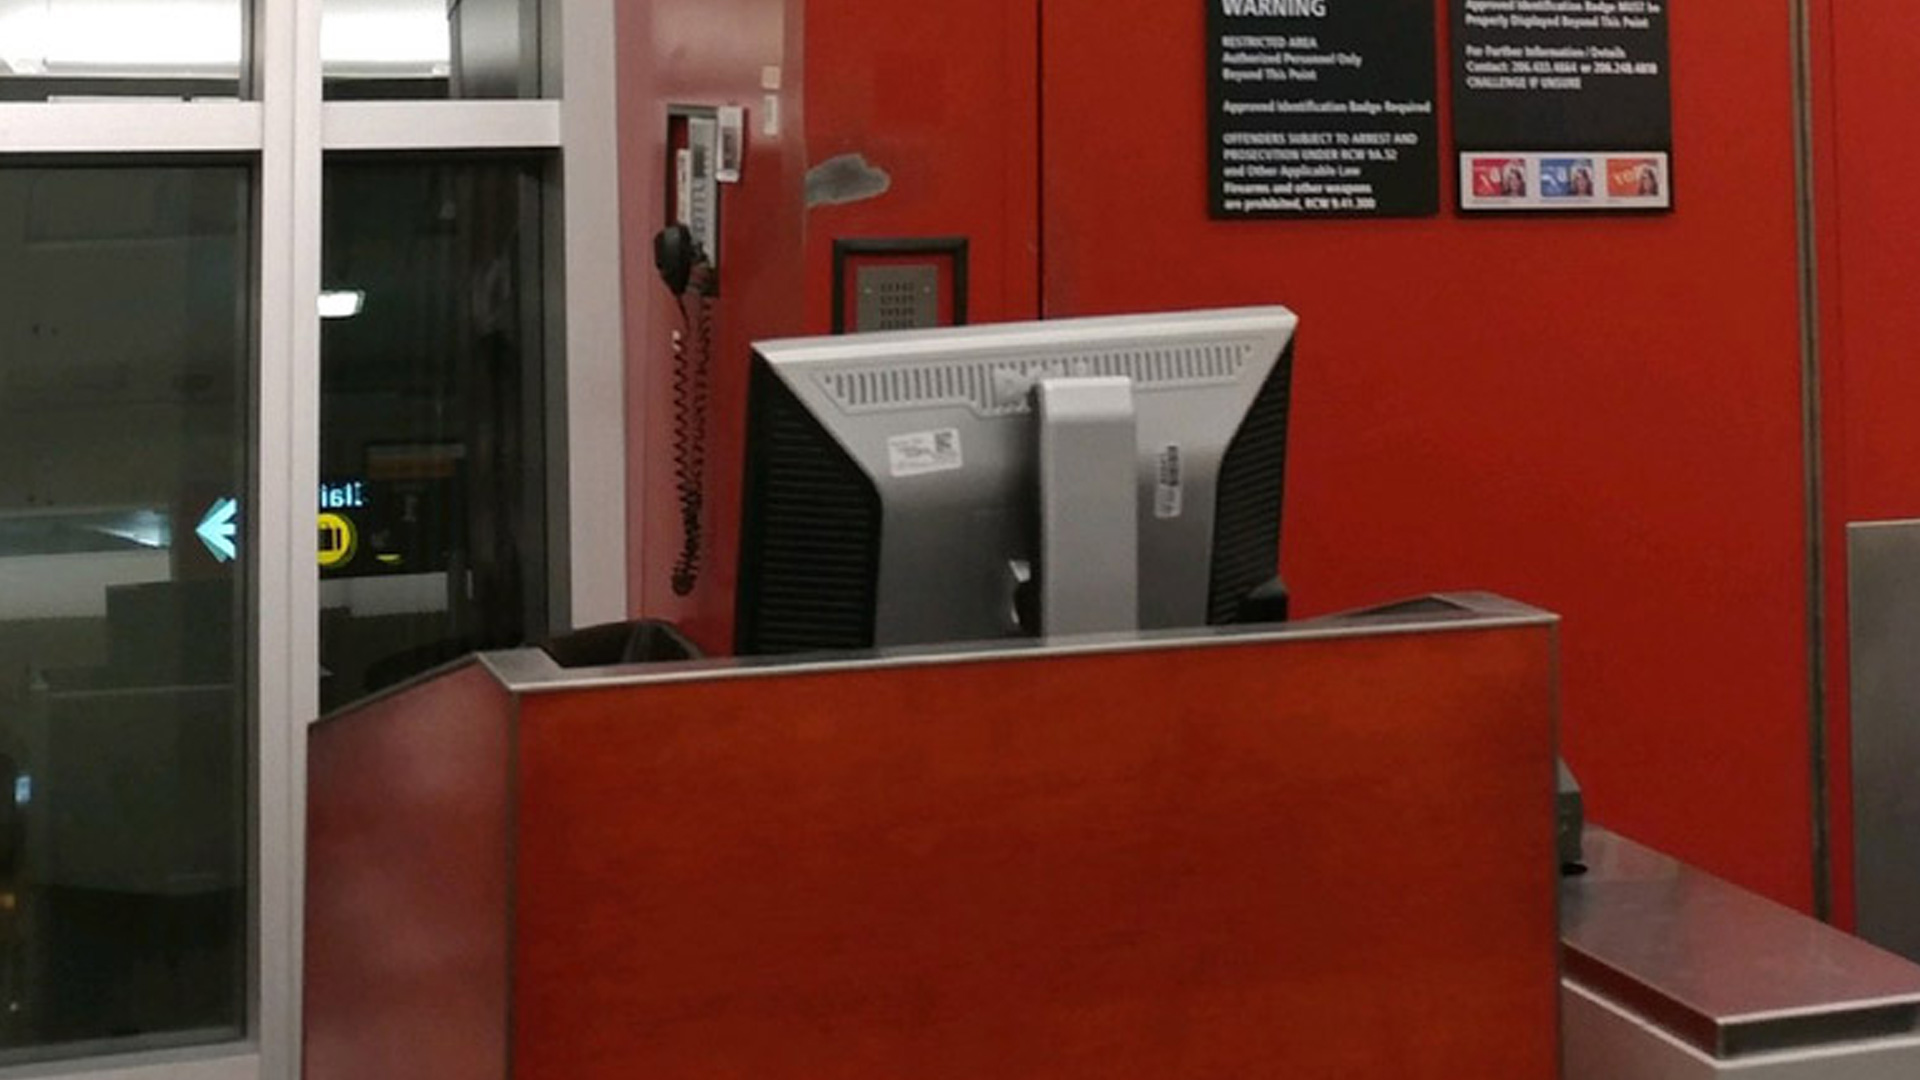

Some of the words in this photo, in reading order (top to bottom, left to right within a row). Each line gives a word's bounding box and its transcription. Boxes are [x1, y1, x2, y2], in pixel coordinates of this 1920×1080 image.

[1223, 0, 1326, 16] WARNING
[1465, 0, 1514, 12] Approved
[1518, 0, 1582, 12] Identification
[1585, 1, 1615, 13] Badge
[1619, 1, 1644, 12] MUST
[1647, 1, 1660, 12] be
[1465, 14, 1508, 28] Properly
[1510, 15, 1559, 29] Displayed
[1562, 16, 1598, 28] Beyond
[1600, 16, 1621, 27] This
[1623, 16, 1649, 28] Point
[1222, 35, 1286, 48] RESTRICTED
[1288, 36, 1318, 48] AREA
[1465, 45, 1483, 56] For
[1485, 45, 1522, 56] Further
[1222, 52, 1281, 64] Authorized
[1283, 53, 1335, 64] Personnel
[1337, 53, 1362, 68] Only
[1222, 68, 1262, 82] Beyond
[1265, 69, 1286, 80] This
[1288, 69, 1317, 80] Point
[1580, 64, 1592, 73] or
[1466, 77, 1526, 88] CHALLENGE
[1529, 77, 1539, 88] IF
[1540, 77, 1581, 89] UNSURE
[1223, 101, 1274, 115] Approved
[1277, 101, 1347, 112] Identification
[1350, 101, 1382, 115] Badge
[1384, 101, 1431, 115] Required
[1223, 133, 1286, 144] OFFENDERS
[1288, 133, 1334, 144] SUBJECT
[1335, 133, 1350, 144] TO
[1352, 133, 1391, 144] ARREST
[1393, 133, 1418, 144] AND
[1223, 149, 1299, 160] PROSECUTION
[1302, 149, 1338, 160] UNDER
[1341, 149, 1365, 160] RCW
[1223, 165, 1244, 176] and
[1247, 165, 1277, 176] Other
[1280, 165, 1336, 179] Applicable
[1338, 166, 1361, 176] Law
[1223, 182, 1270, 193] Firearms
[1272, 183, 1292, 193] and
[1295, 183, 1322, 193] other
[1325, 185, 1372, 195] weapons
[1224, 200, 1241, 209] are
[1304, 198, 1330, 209] RCW
